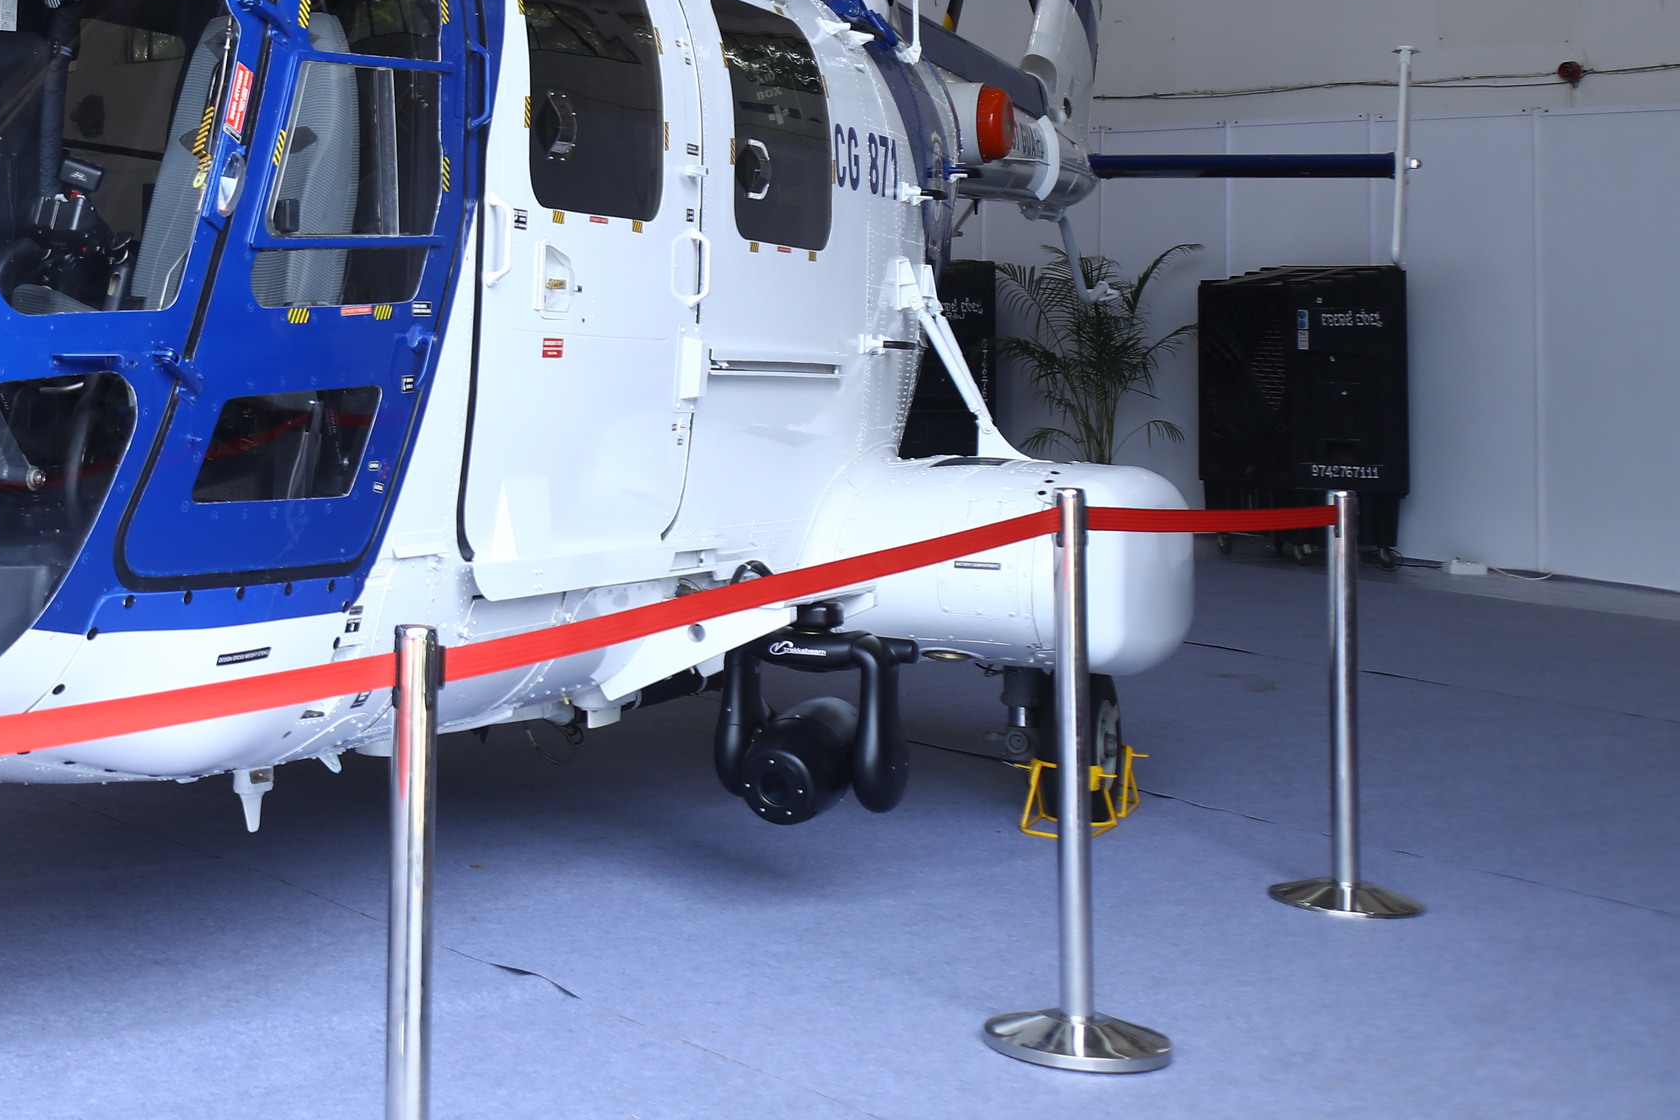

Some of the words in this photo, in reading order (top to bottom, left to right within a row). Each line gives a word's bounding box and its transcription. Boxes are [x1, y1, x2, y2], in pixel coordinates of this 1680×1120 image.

[756, 86, 783, 101] BOX
[835, 123, 861, 191] CG
[868, 132, 898, 201] 871
[1311, 464, 1380, 479] 9742767111
